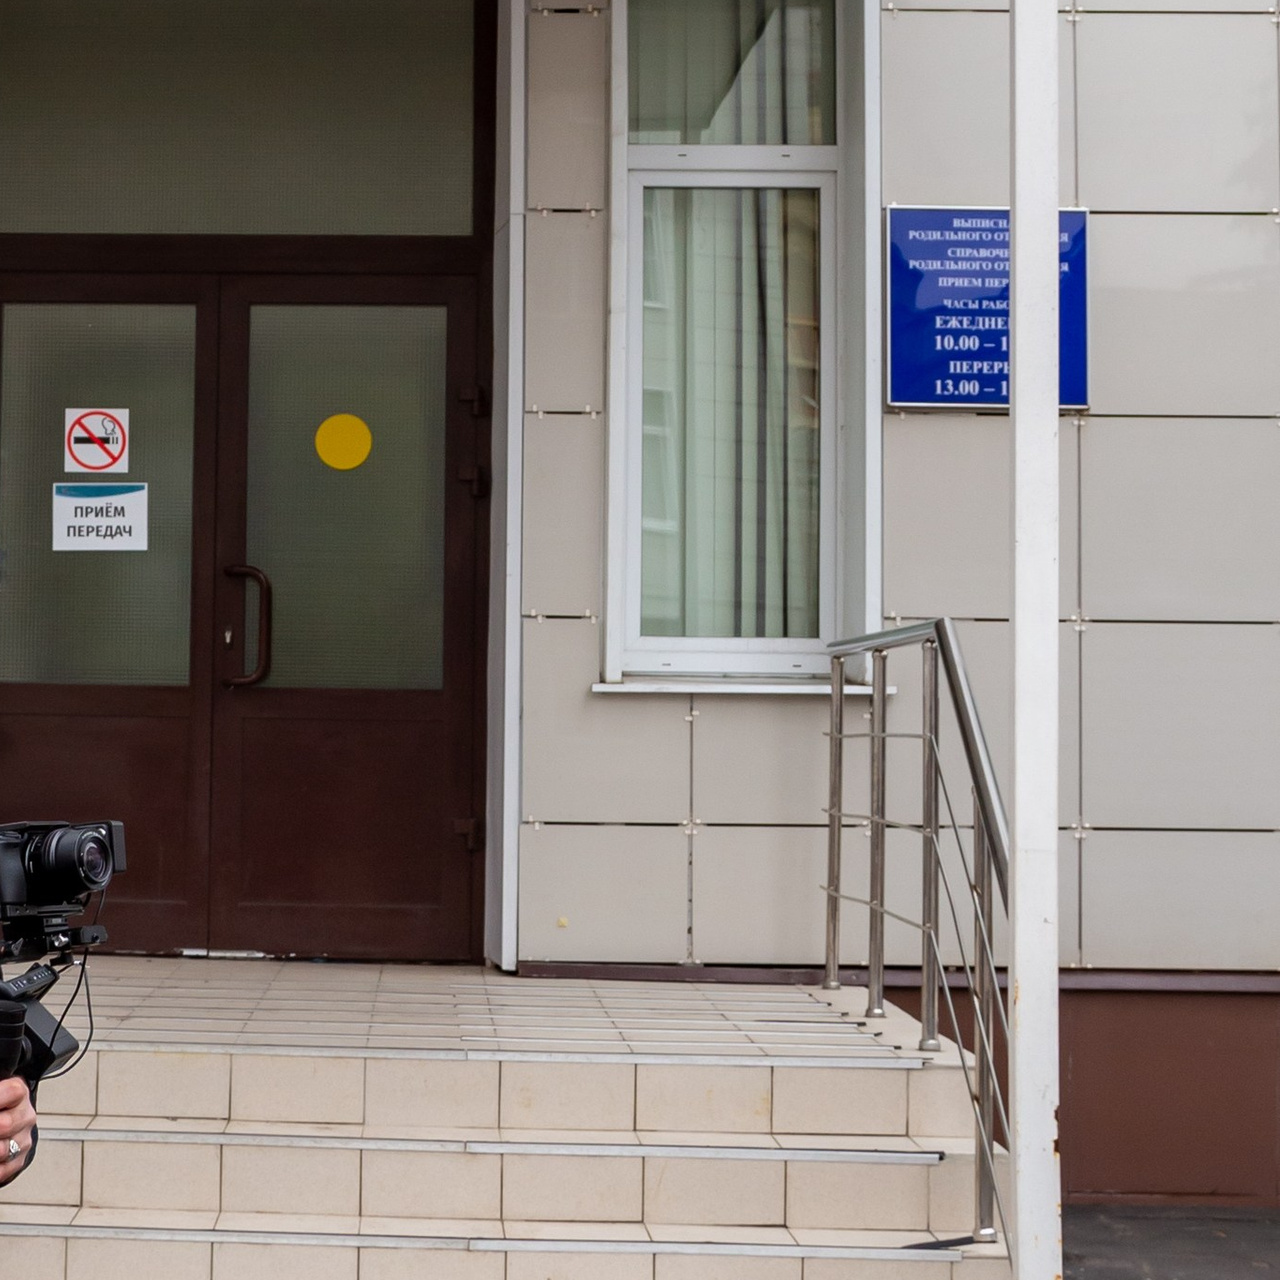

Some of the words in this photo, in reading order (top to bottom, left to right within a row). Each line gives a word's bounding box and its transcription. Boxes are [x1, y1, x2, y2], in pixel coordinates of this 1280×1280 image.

[952, 218, 1009, 229] ВЫПИСН
[908, 230, 992, 241] РОДИЛЬНОГО
[908, 260, 992, 271] РОДИЛЬНОГО
[938, 277, 982, 287] ПРИЕМ
[943, 299, 979, 309] ЧАСЫ
[935, 315, 1009, 331] ЕЖЕДНЕ
[935, 335, 980, 351] 10.00
[935, 379, 980, 395] 13.00
[74, 502, 126, 518] ПРИЁМ
[67, 525, 133, 539] ПЕРЕДАЧ
